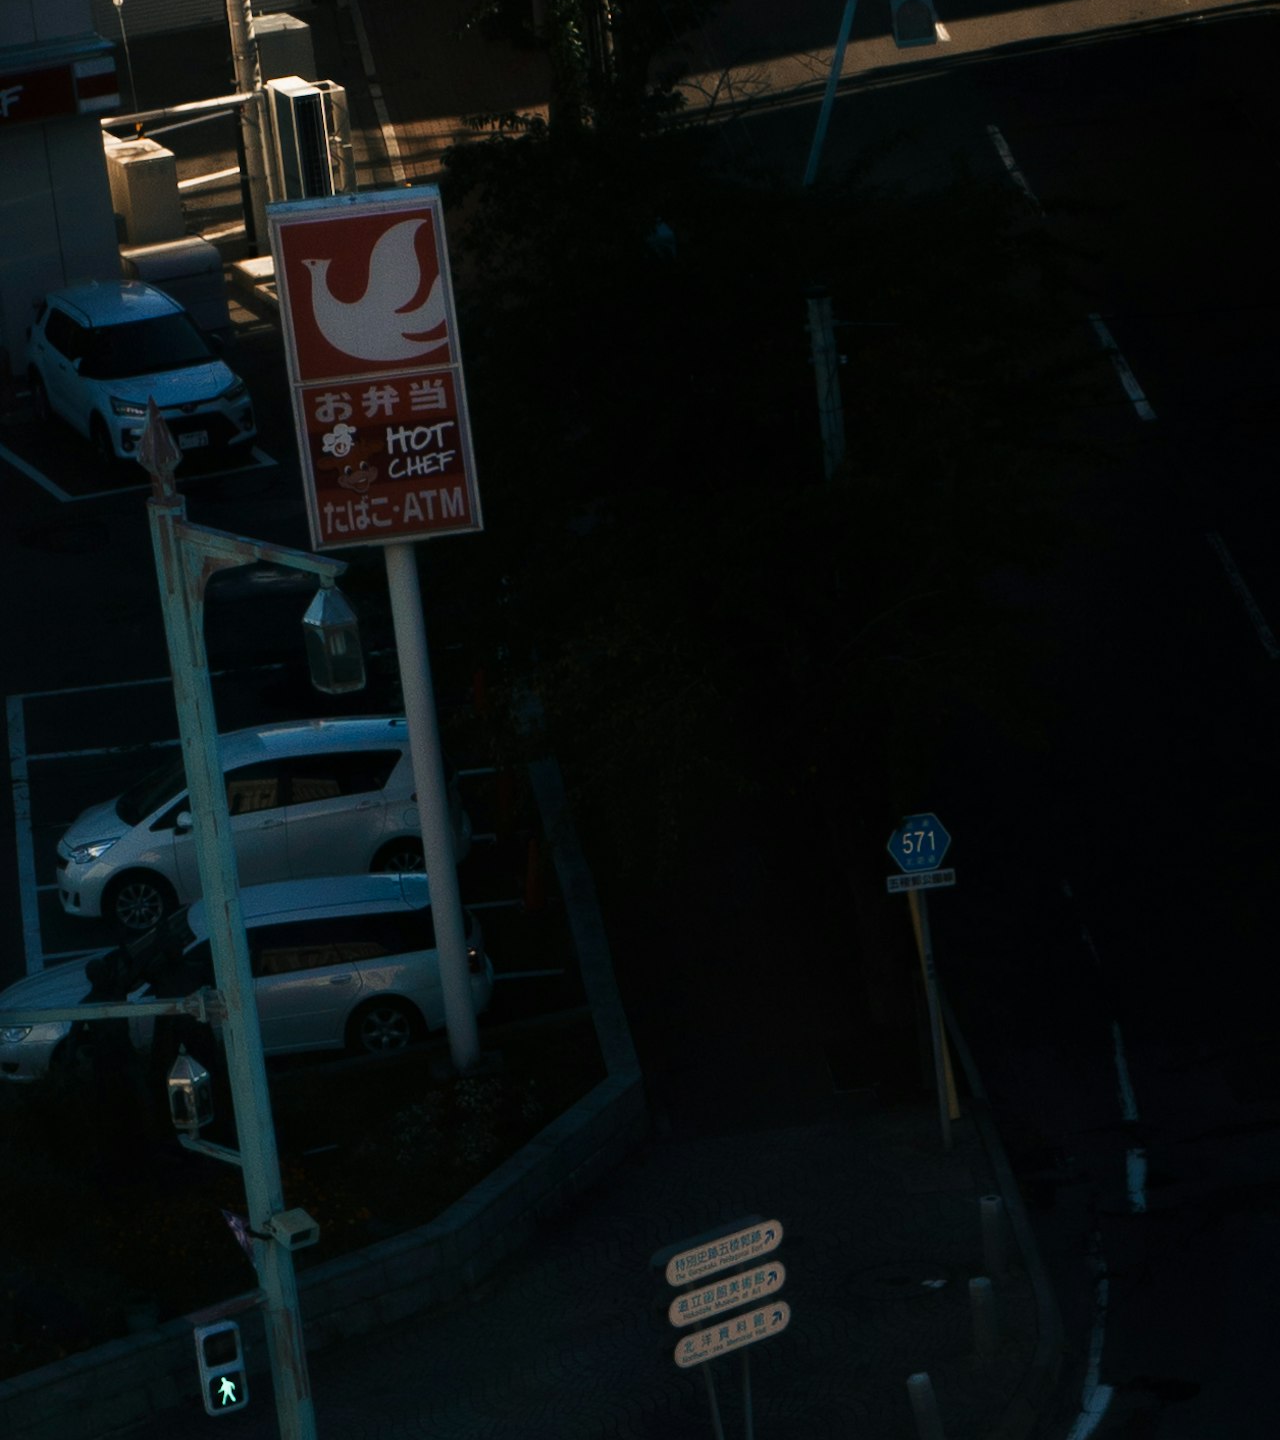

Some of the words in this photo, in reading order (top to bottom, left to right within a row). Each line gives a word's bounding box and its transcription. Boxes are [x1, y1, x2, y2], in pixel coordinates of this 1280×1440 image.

[315, 379, 448, 423] お弁当
[386, 421, 455, 455] HOT
[388, 449, 456, 479] CHEF
[902, 829, 935, 854] 571
